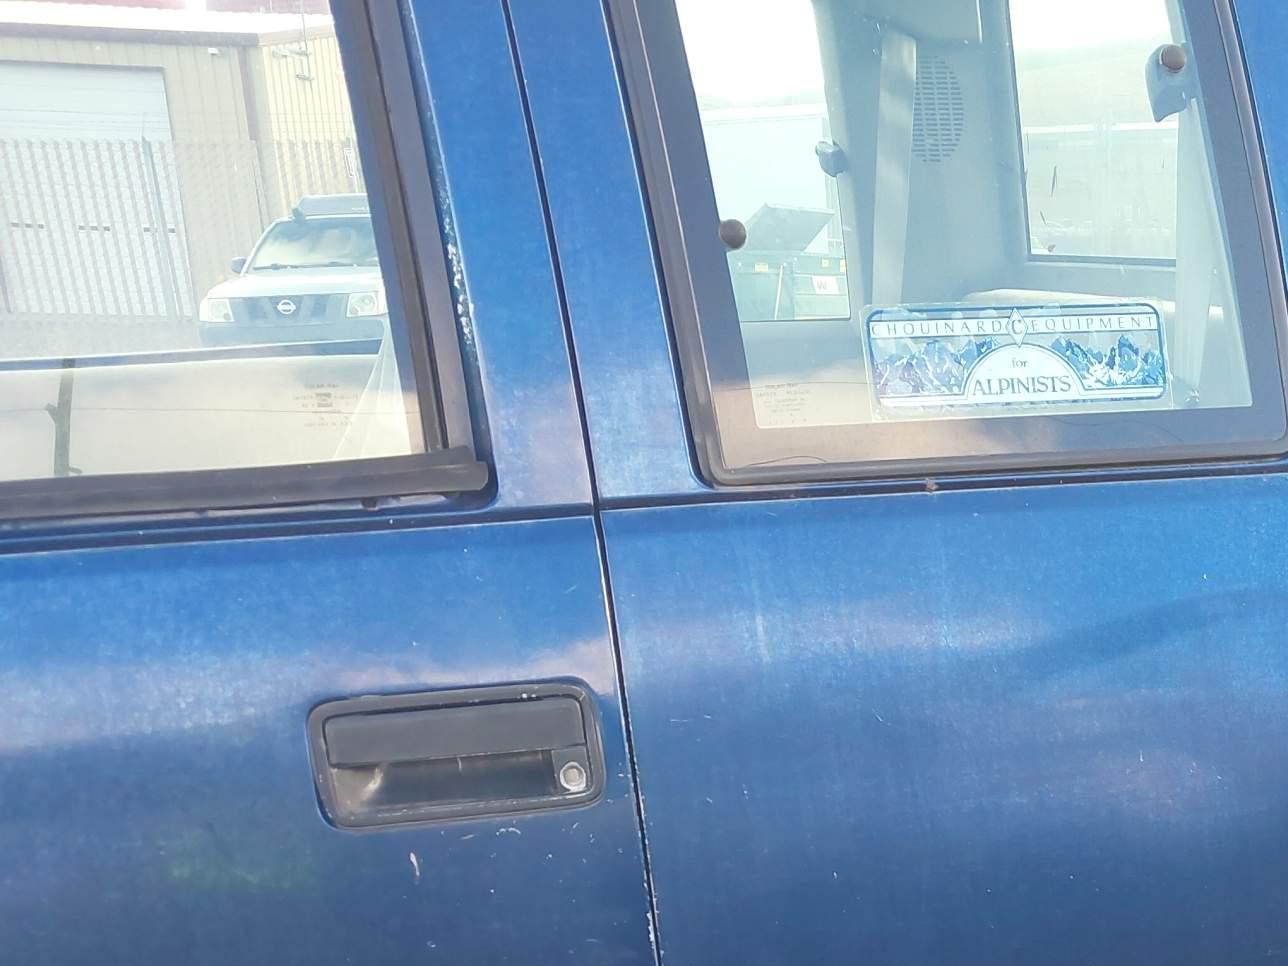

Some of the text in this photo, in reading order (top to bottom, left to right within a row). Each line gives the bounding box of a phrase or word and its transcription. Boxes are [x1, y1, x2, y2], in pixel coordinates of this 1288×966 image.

[871, 319, 1002, 336] CHOUINARD
[1031, 315, 1154, 332] EQUIPMENT
[1011, 356, 1028, 368] for
[972, 375, 1072, 397] ALPINISTS
